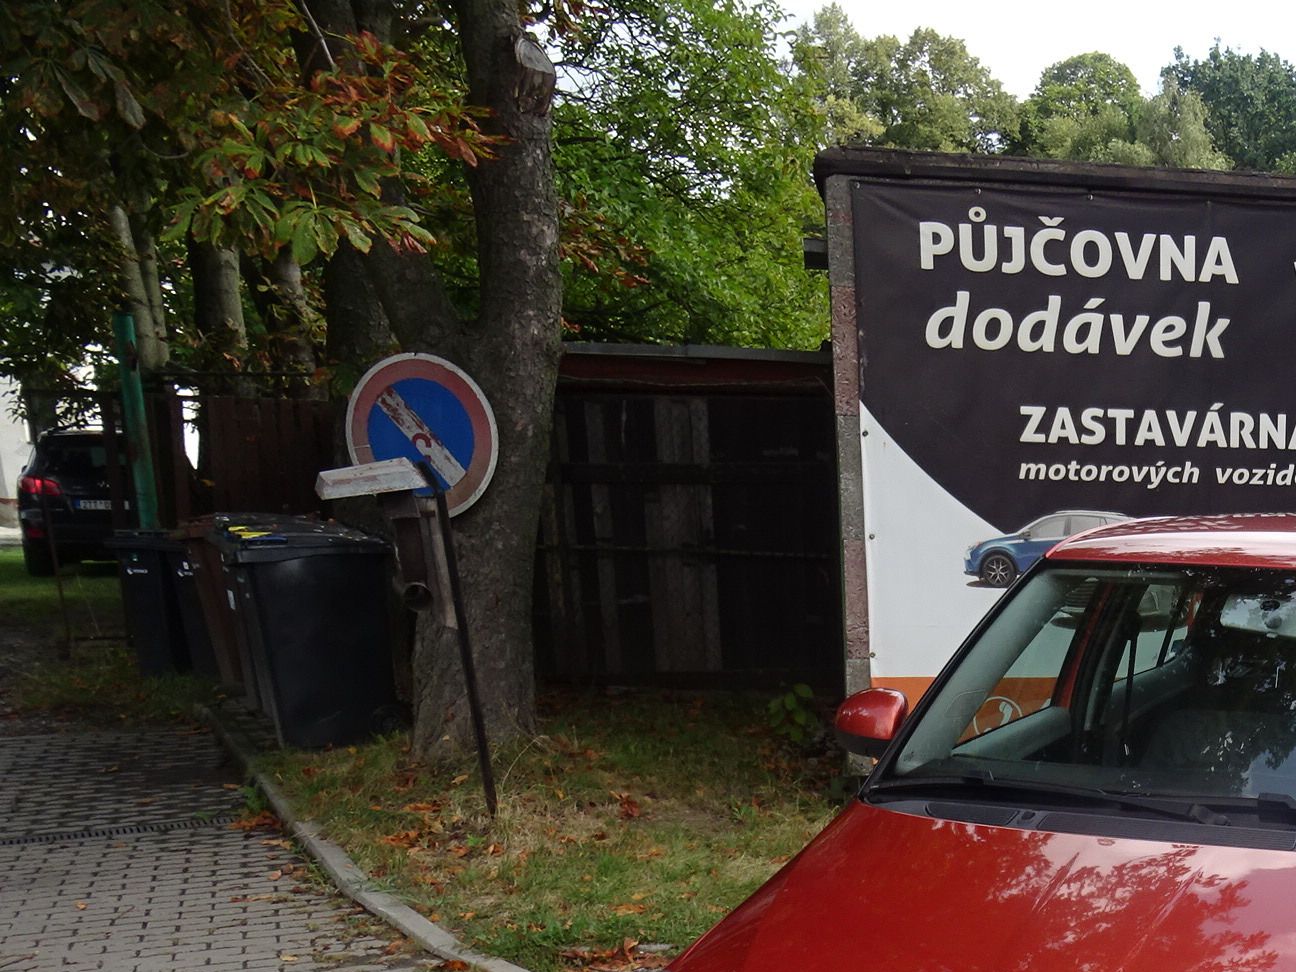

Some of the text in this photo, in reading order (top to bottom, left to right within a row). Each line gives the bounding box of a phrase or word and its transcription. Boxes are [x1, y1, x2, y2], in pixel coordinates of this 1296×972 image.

[918, 206, 1239, 285] PŮJČOVNA
[924, 290, 1231, 359] dodávek
[1018, 460, 1200, 490] motorových
